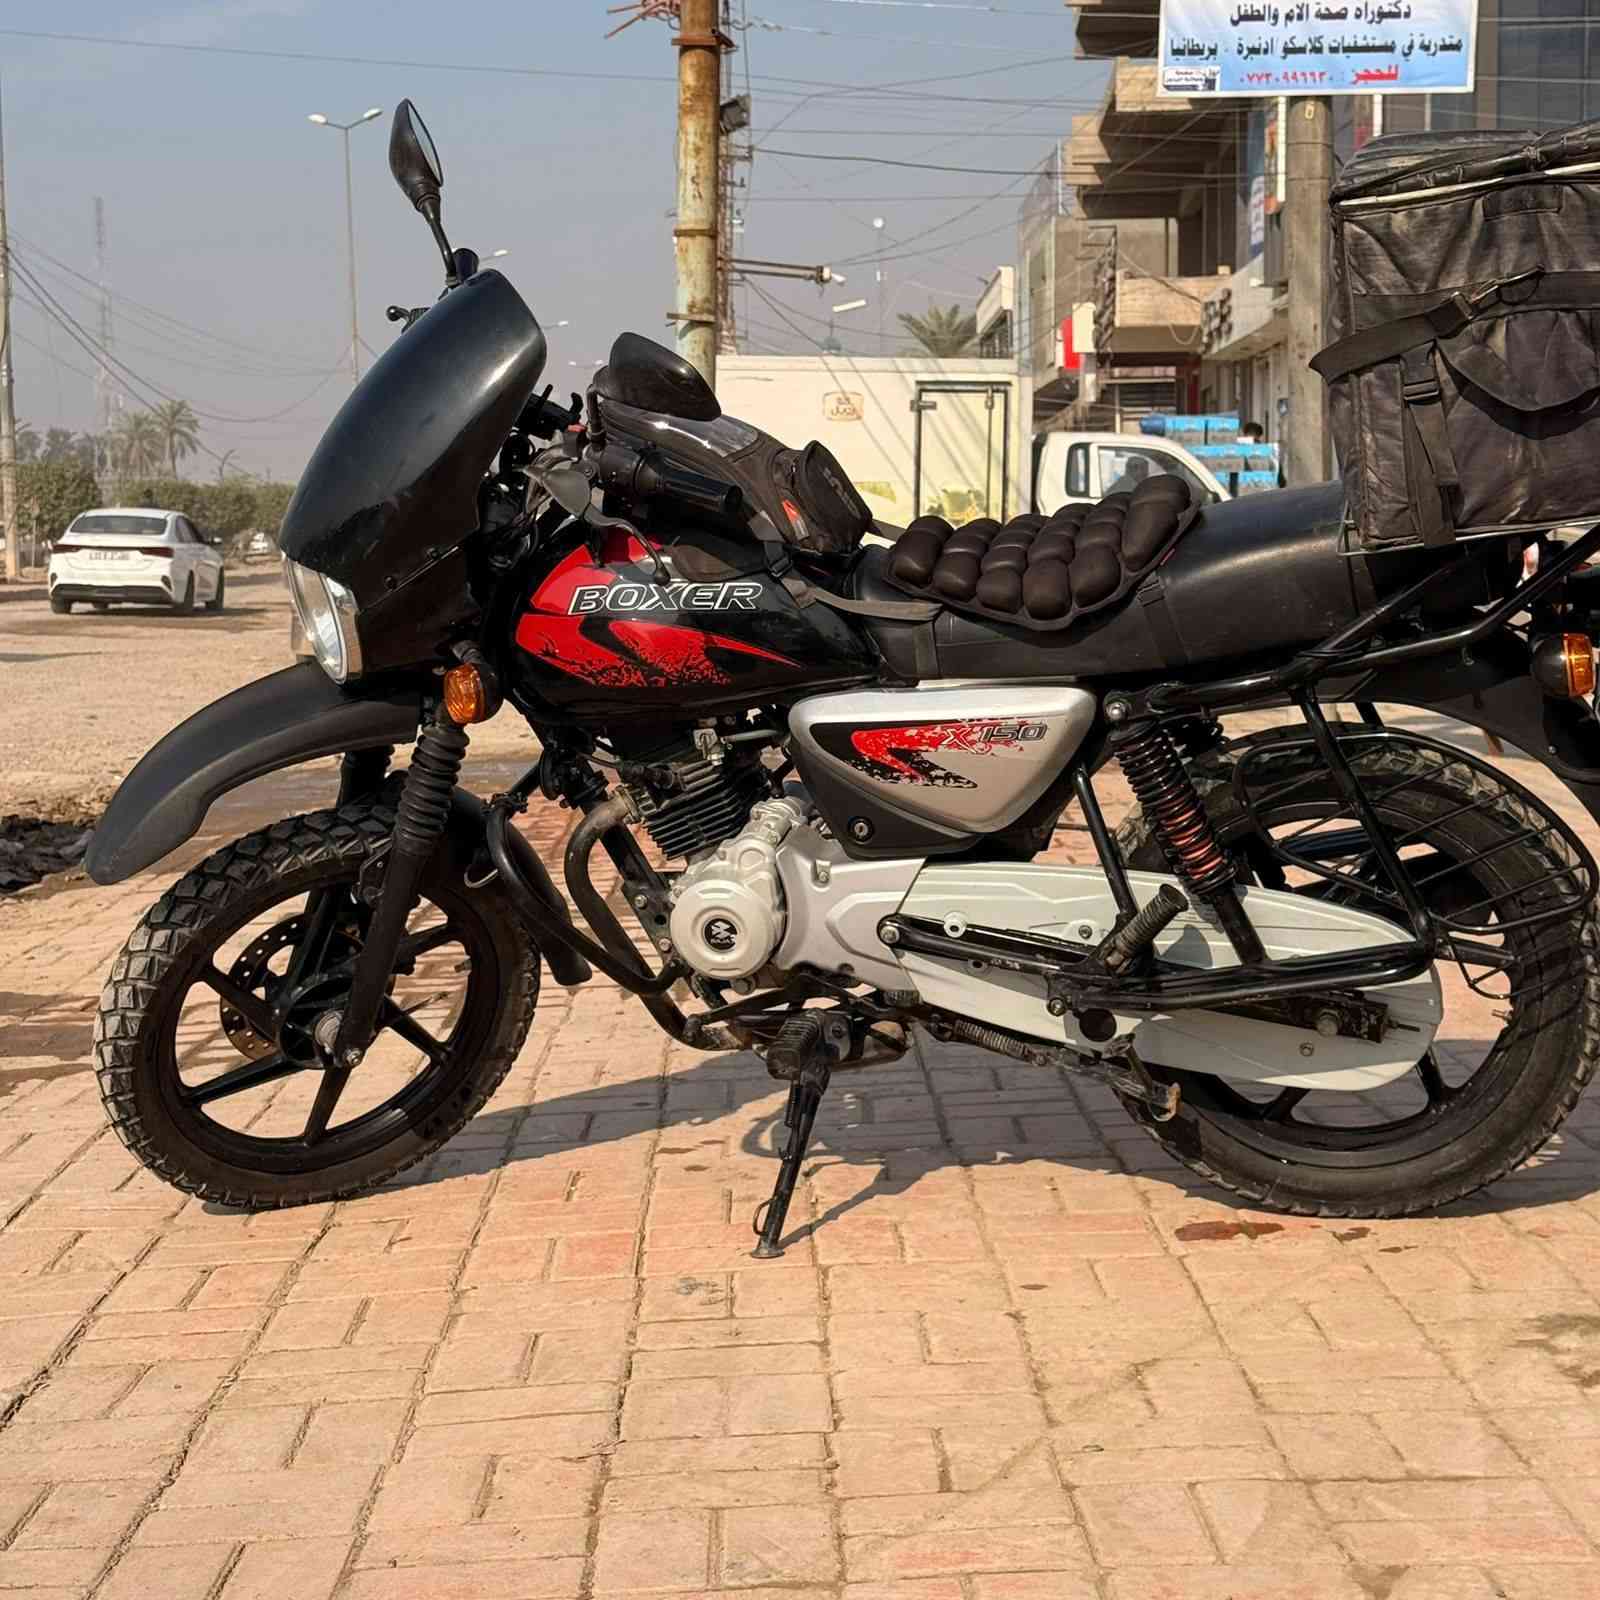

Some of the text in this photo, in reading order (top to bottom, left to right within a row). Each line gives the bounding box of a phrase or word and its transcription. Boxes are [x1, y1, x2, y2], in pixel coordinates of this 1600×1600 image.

[1230, 0, 1412, 28] دكتوراه صحة الام والطفل
[1170, 36, 1218, 61] بريطانيا
[1328, 33, 1396, 58] مستشفيات
[1401, 32, 1414, 62] في
[567, 582, 763, 616] BOXER
[977, 723, 1048, 743] 150
